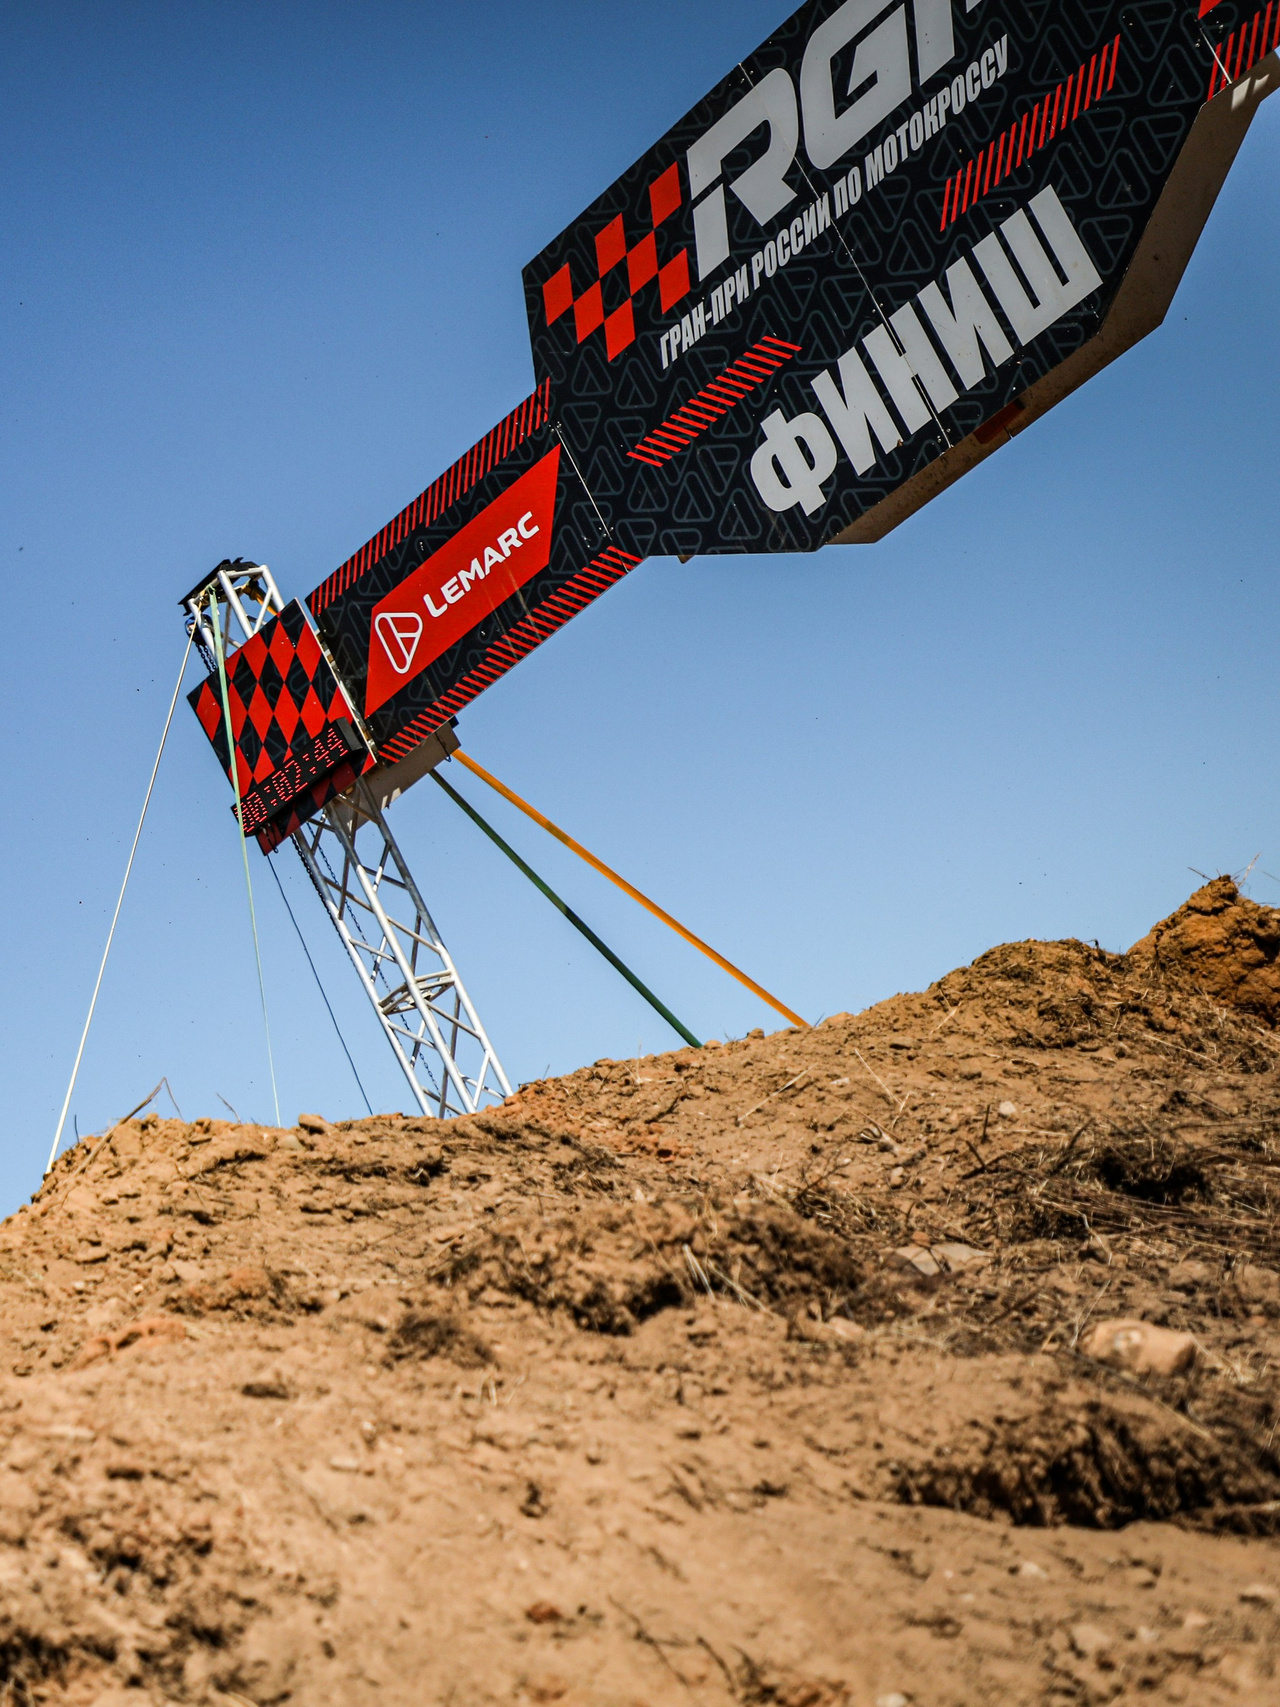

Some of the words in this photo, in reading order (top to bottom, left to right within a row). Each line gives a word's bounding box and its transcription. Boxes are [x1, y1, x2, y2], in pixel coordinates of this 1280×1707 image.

[660, 263, 750, 370] ГРАН-ПРИ
[751, 192, 831, 291] РОССИИ
[833, 166, 862, 220] ПО
[865, 33, 1008, 192] МОТОКРОССУ
[750, 184, 1103, 517] ФИНИШ
[423, 511, 540, 618] LEMARC
